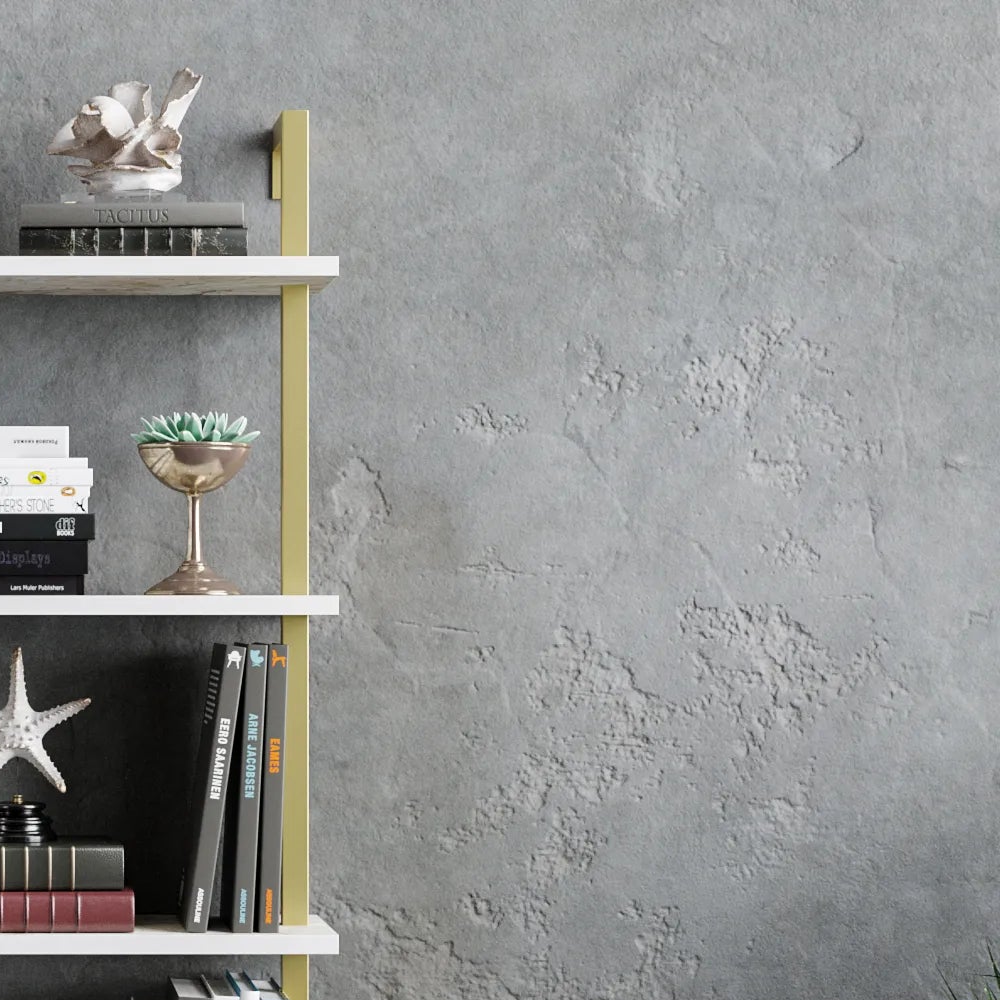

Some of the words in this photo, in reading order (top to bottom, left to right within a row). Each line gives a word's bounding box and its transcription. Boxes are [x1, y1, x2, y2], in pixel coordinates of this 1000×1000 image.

[93, 208, 169, 223] TACITUS
[26, 500, 54, 513] STONE
[55, 517, 76, 530] dif
[0, 551, 50, 568] Displays
[217, 718, 230, 744] EERO
[248, 713, 258, 741] ARNE
[269, 738, 280, 774] EAMES
[210, 748, 227, 800] SAARINEN
[244, 744, 257, 798] JACOBSEN
